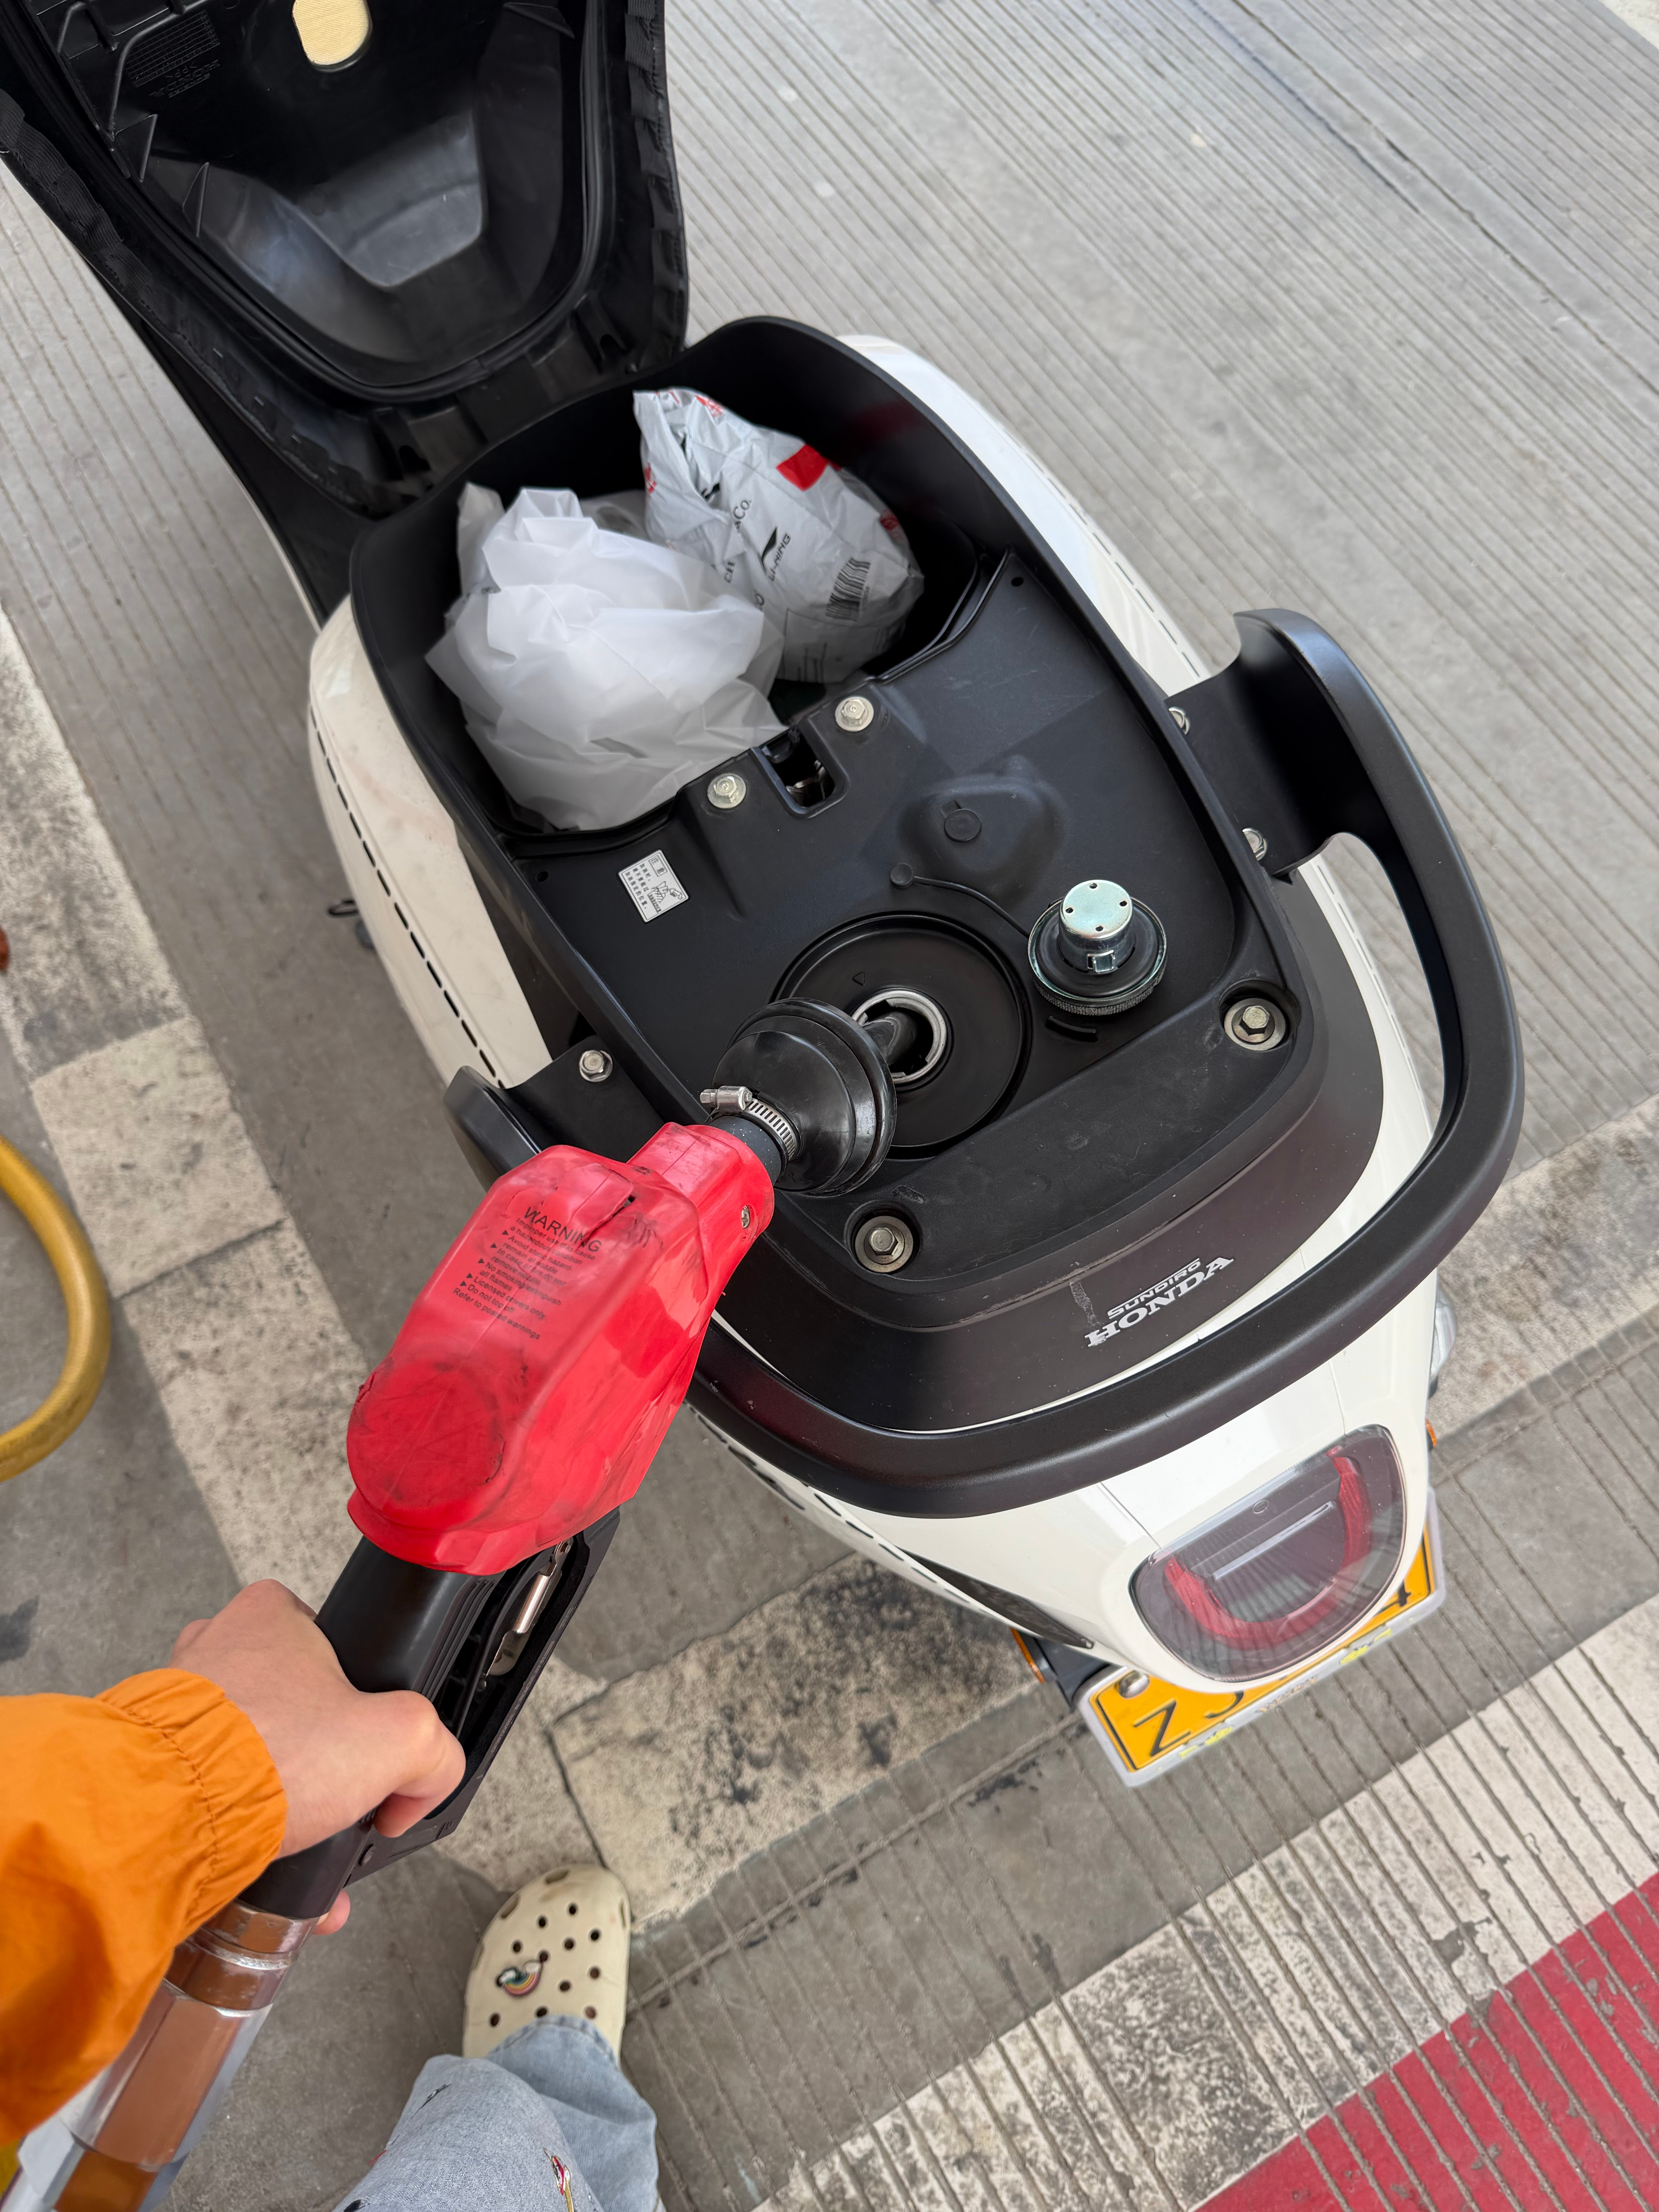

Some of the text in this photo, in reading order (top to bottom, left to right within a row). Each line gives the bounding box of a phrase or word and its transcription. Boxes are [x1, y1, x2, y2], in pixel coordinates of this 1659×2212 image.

[497, 1247, 506, 1255] In
[524, 1207, 602, 1252] WARNING
[479, 1269, 513, 1291] all flames
[485, 1261, 497, 1272] No
[1108, 1260, 1201, 1318] SUNDIRO
[453, 1287, 474, 1303] Refer
[473, 1299, 483, 1309] to
[507, 1318, 541, 1340] warnings
[467, 1283, 479, 1295] Do
[479, 1291, 492, 1302] not
[491, 1298, 504, 1309] top
[473, 1275, 506, 1298] Licensed
[529, 1307, 547, 1321] only
[1085, 1257, 1234, 1347] HONDA
